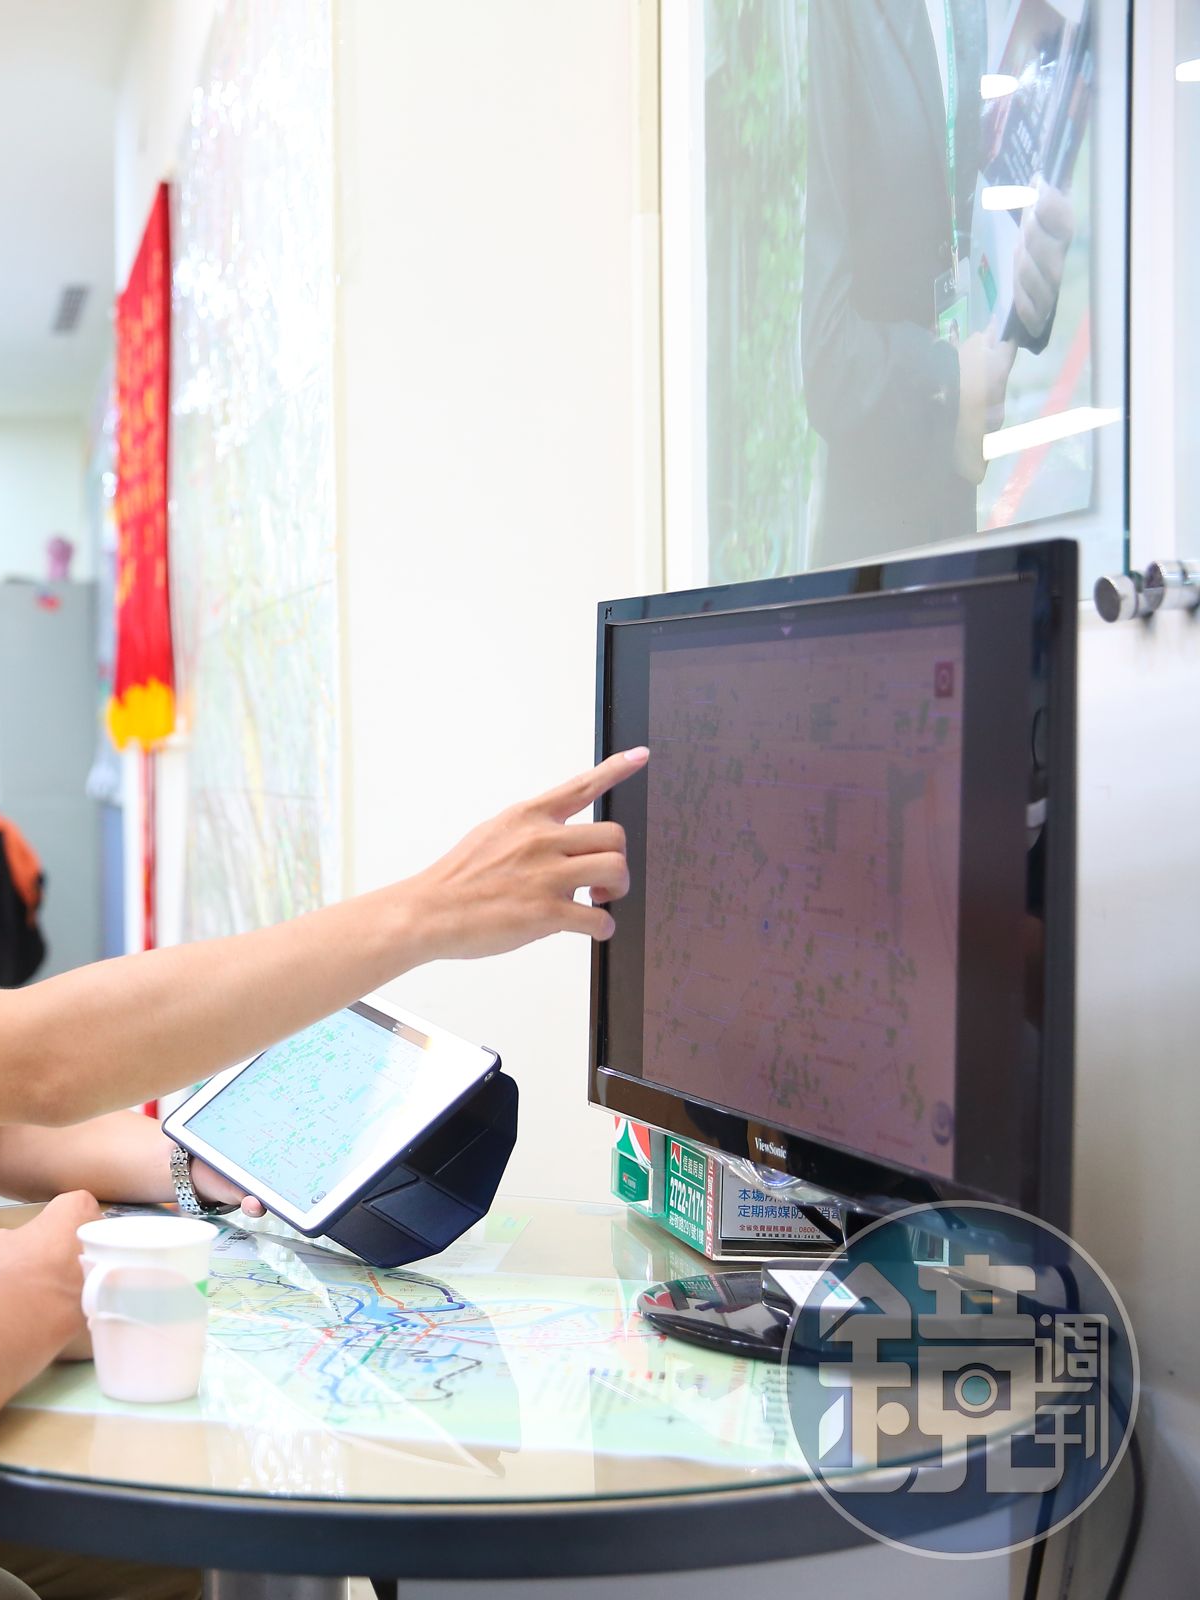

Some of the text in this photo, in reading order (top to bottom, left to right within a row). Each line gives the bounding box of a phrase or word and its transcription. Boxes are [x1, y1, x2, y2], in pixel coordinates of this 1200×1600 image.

[754, 1137, 787, 1159] ViewSonic
[669, 1176, 704, 1226] 2722-7171
[737, 1204, 841, 1220] 定期病媒防消毒
